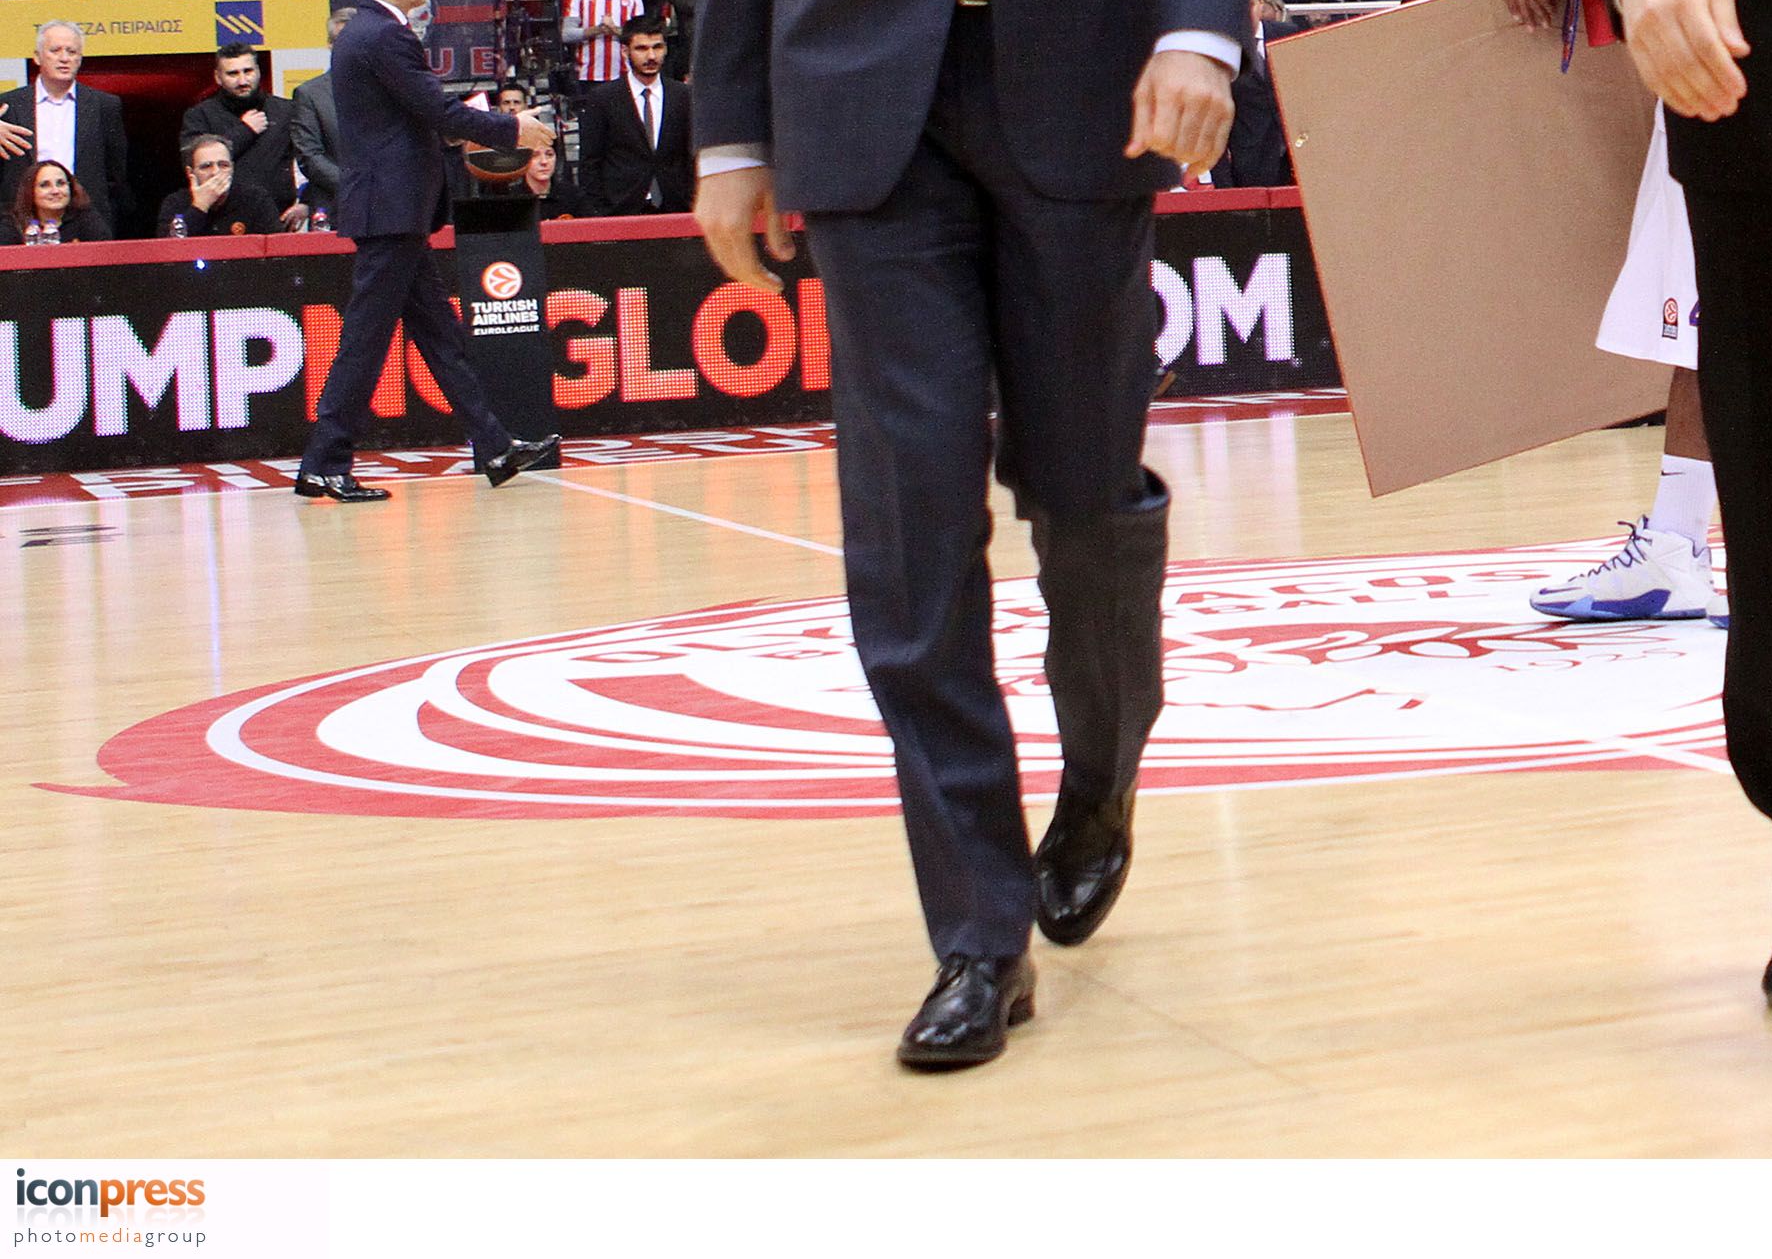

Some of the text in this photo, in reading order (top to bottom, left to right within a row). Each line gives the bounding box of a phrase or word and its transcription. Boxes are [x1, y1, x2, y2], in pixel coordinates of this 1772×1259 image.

[34, 19, 183, 37] ΤΕΖΑ ΠΕΙΡΑΙΩΣ
[471, 298, 538, 314] TURKISH
[472, 311, 539, 326] AIRLINES
[473, 324, 540, 336] EUROLEAGUE
